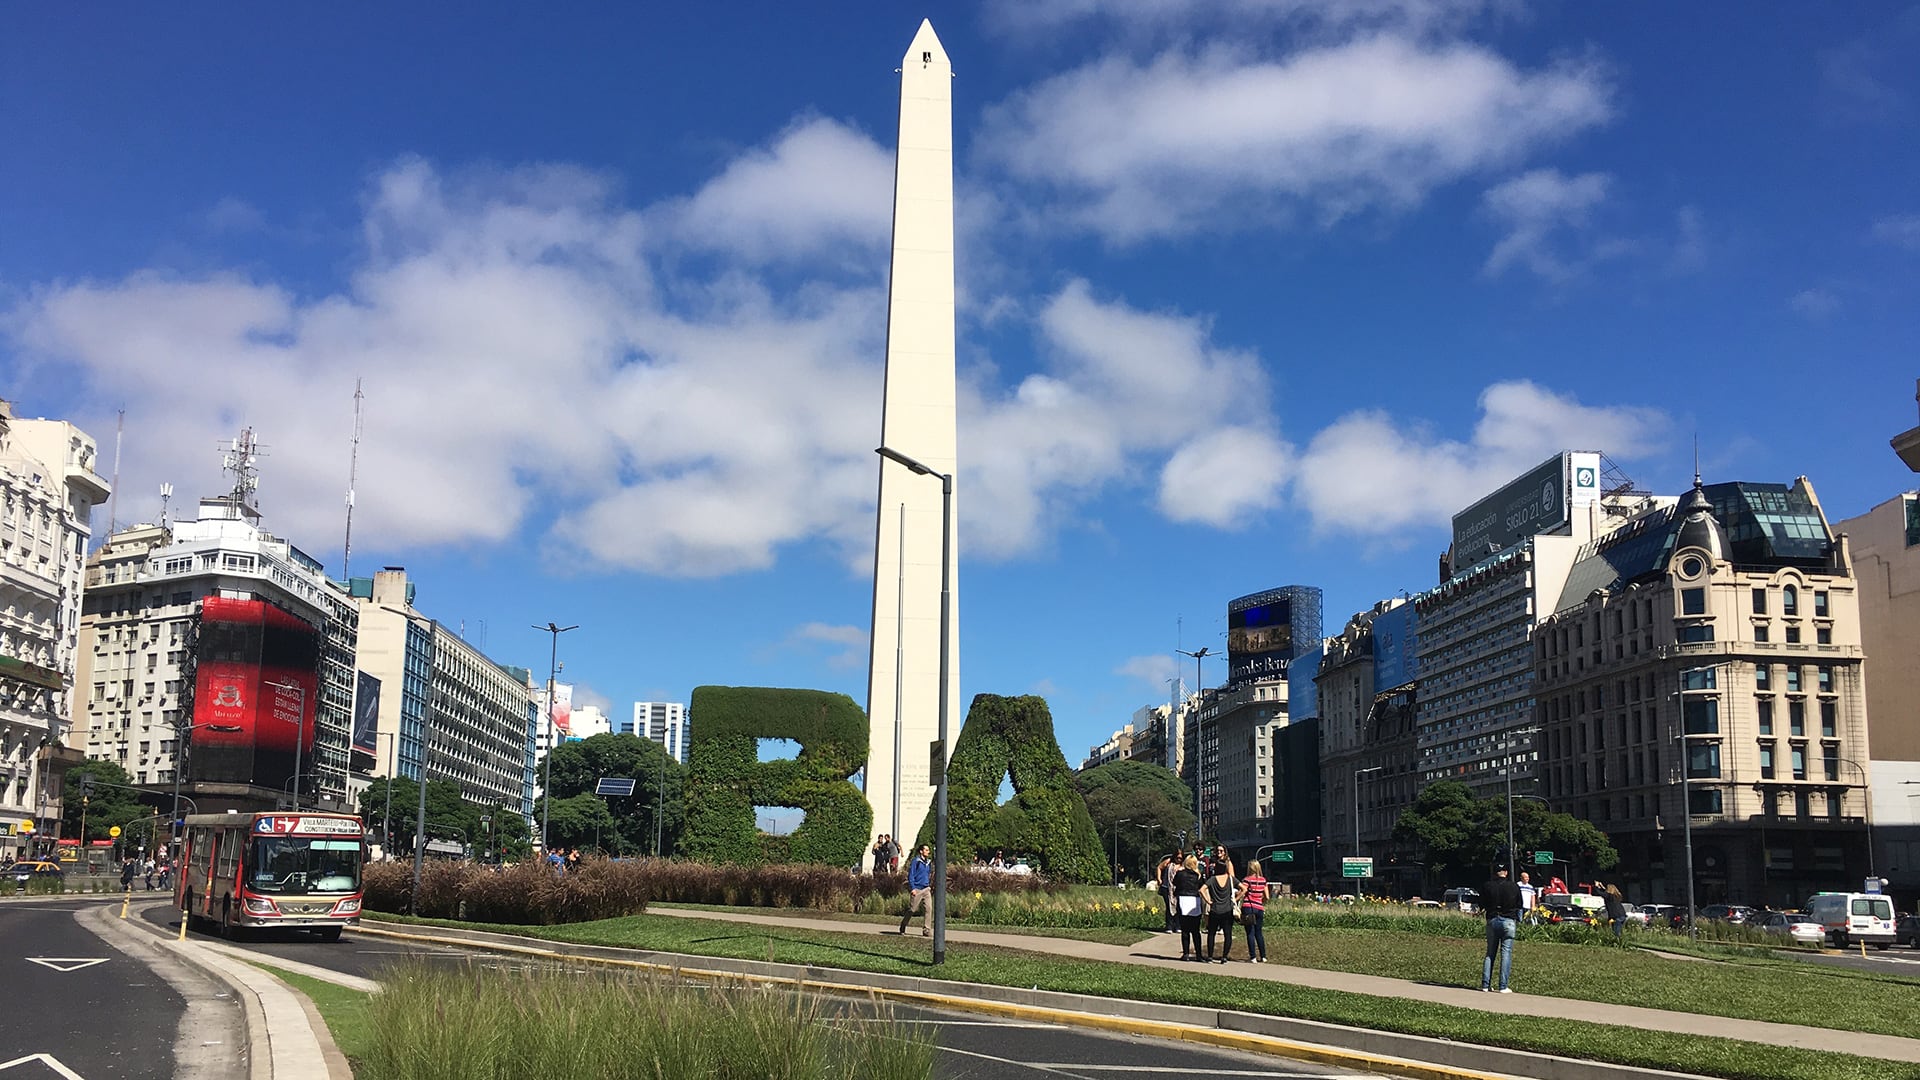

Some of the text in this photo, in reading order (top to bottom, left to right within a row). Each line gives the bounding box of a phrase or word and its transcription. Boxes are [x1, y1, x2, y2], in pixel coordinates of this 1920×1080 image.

[1458, 511, 1497, 543] La educación
[1506, 501, 1539, 533] SIGLO 21
[273, 817, 300, 834] 67
